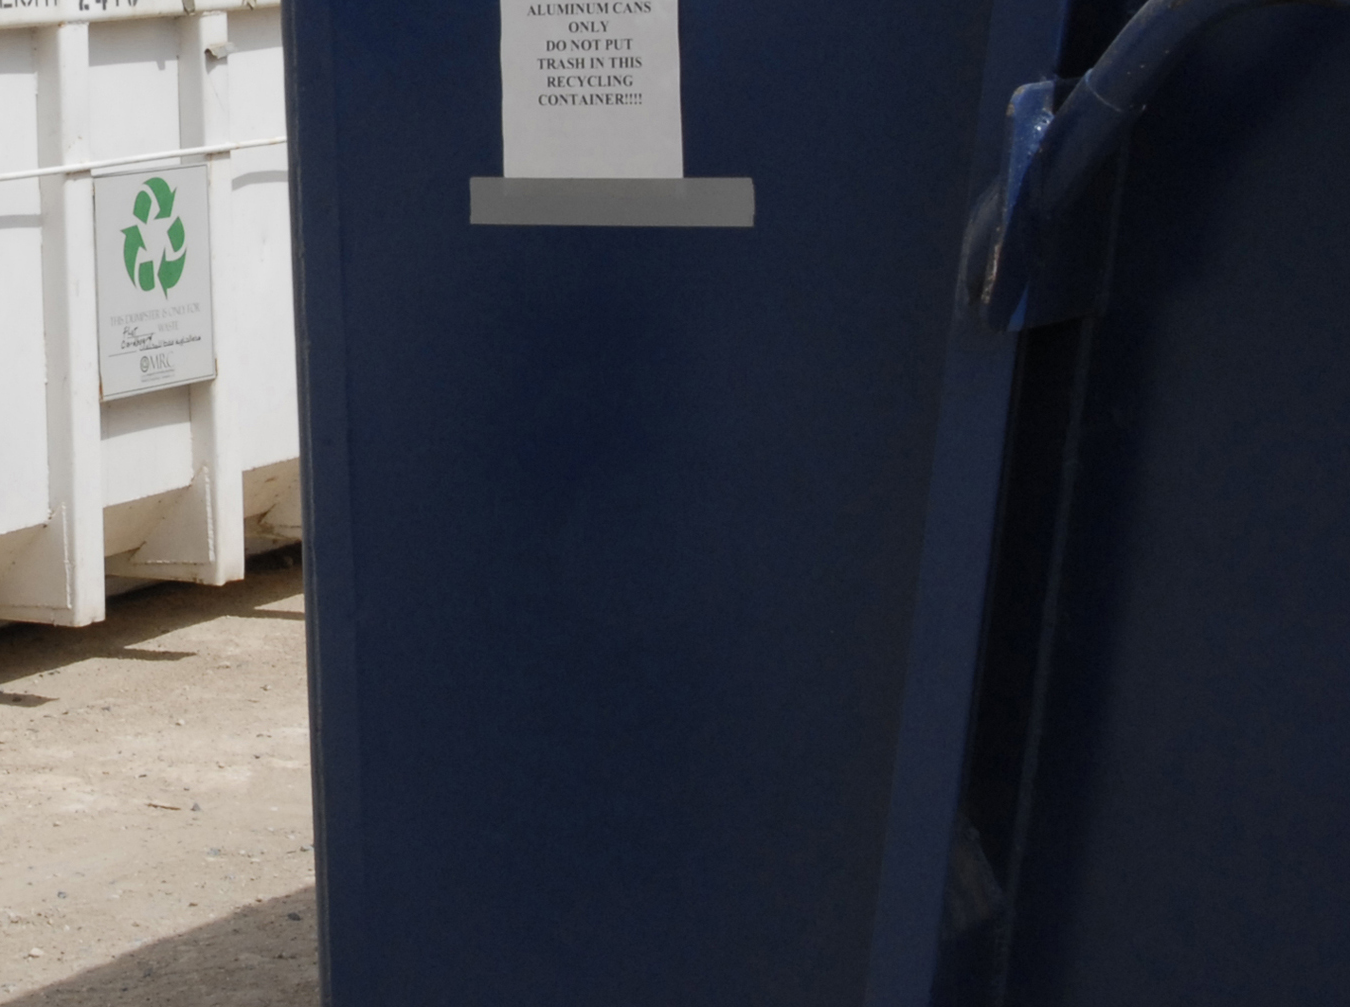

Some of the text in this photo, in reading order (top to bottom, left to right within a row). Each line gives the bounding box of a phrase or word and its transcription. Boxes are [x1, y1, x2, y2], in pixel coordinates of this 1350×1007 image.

[527, 1, 652, 16] ALUMINUM CANS
[568, 20, 607, 33] ONLY
[546, 38, 633, 52] DO NOT PUT
[537, 56, 643, 70] TRASH IN THIS
[546, 74, 634, 88] RECYCLING
